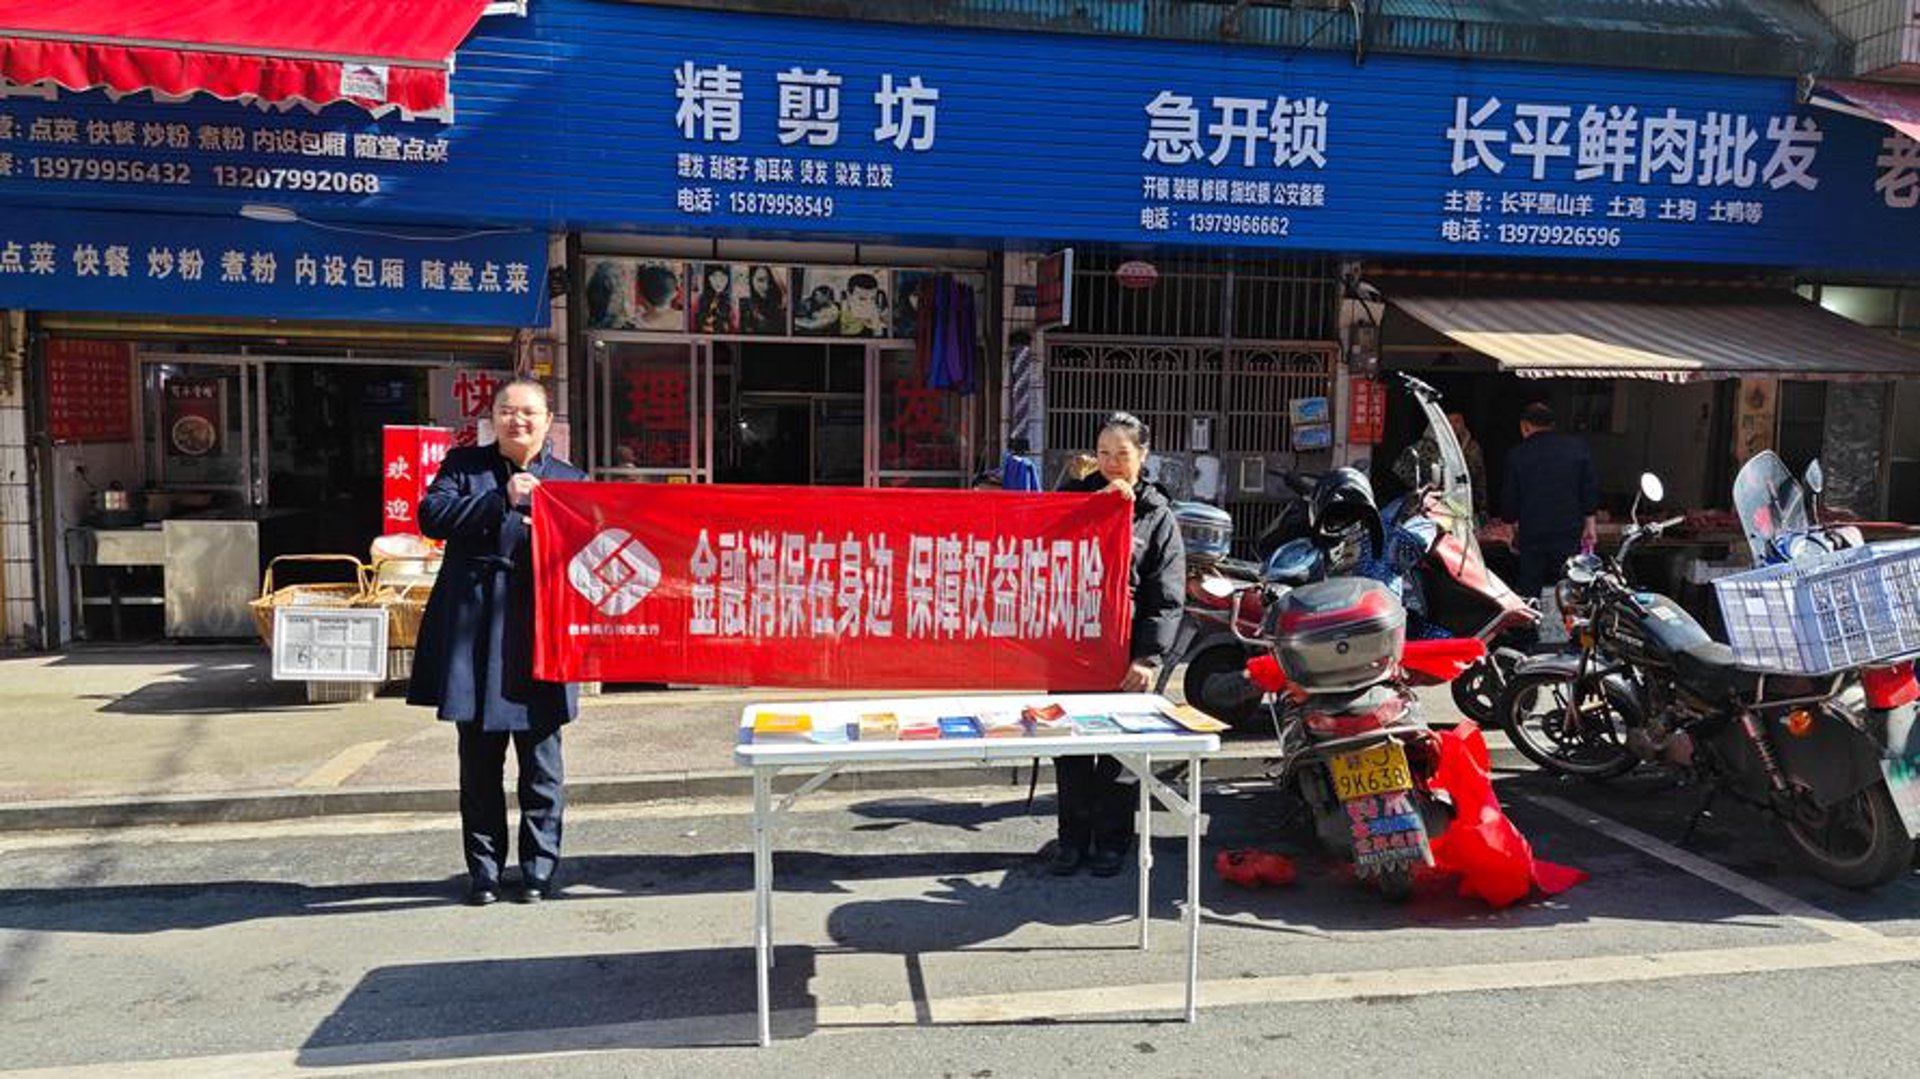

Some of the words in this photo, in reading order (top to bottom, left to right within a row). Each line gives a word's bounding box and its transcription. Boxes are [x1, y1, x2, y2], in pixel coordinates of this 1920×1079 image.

[673, 60, 940, 151] 精剪坊
[1141, 90, 1330, 169] 急开锁
[87, 118, 136, 146] 快餐
[142, 121, 190, 148] 炒粉
[199, 124, 246, 150] 煮粉
[252, 126, 347, 157] 内设包厢
[353, 132, 449, 163] 随堂点菜
[1446, 96, 1823, 191] 长平鲜肉批发
[212, 164, 381, 194] 13207992068
[677, 153, 705, 179] 理发
[709, 155, 749, 181] 刮胡子
[800, 159, 828, 185] 烫发
[834, 161, 862, 187] 染发
[1144, 176, 1170, 200] 开锁
[1173, 178, 1200, 201] 装锁
[1202, 178, 1228, 202] 修锁
[1873, 131, 1920, 208] 老
[1606, 196, 1647, 220] 土鸡
[1658, 199, 1697, 222] 土狗
[0, 241, 56, 275] 点菜
[73, 243, 130, 277] 快餐
[148, 246, 204, 280] 炒粉
[221, 249, 277, 283] 煮粉
[295, 252, 404, 288] 内设包厢
[420, 259, 530, 294] 随堂点菜
[689, 528, 894, 645] 金融消保在身边
[906, 532, 1104, 642] 保障权益防风险
